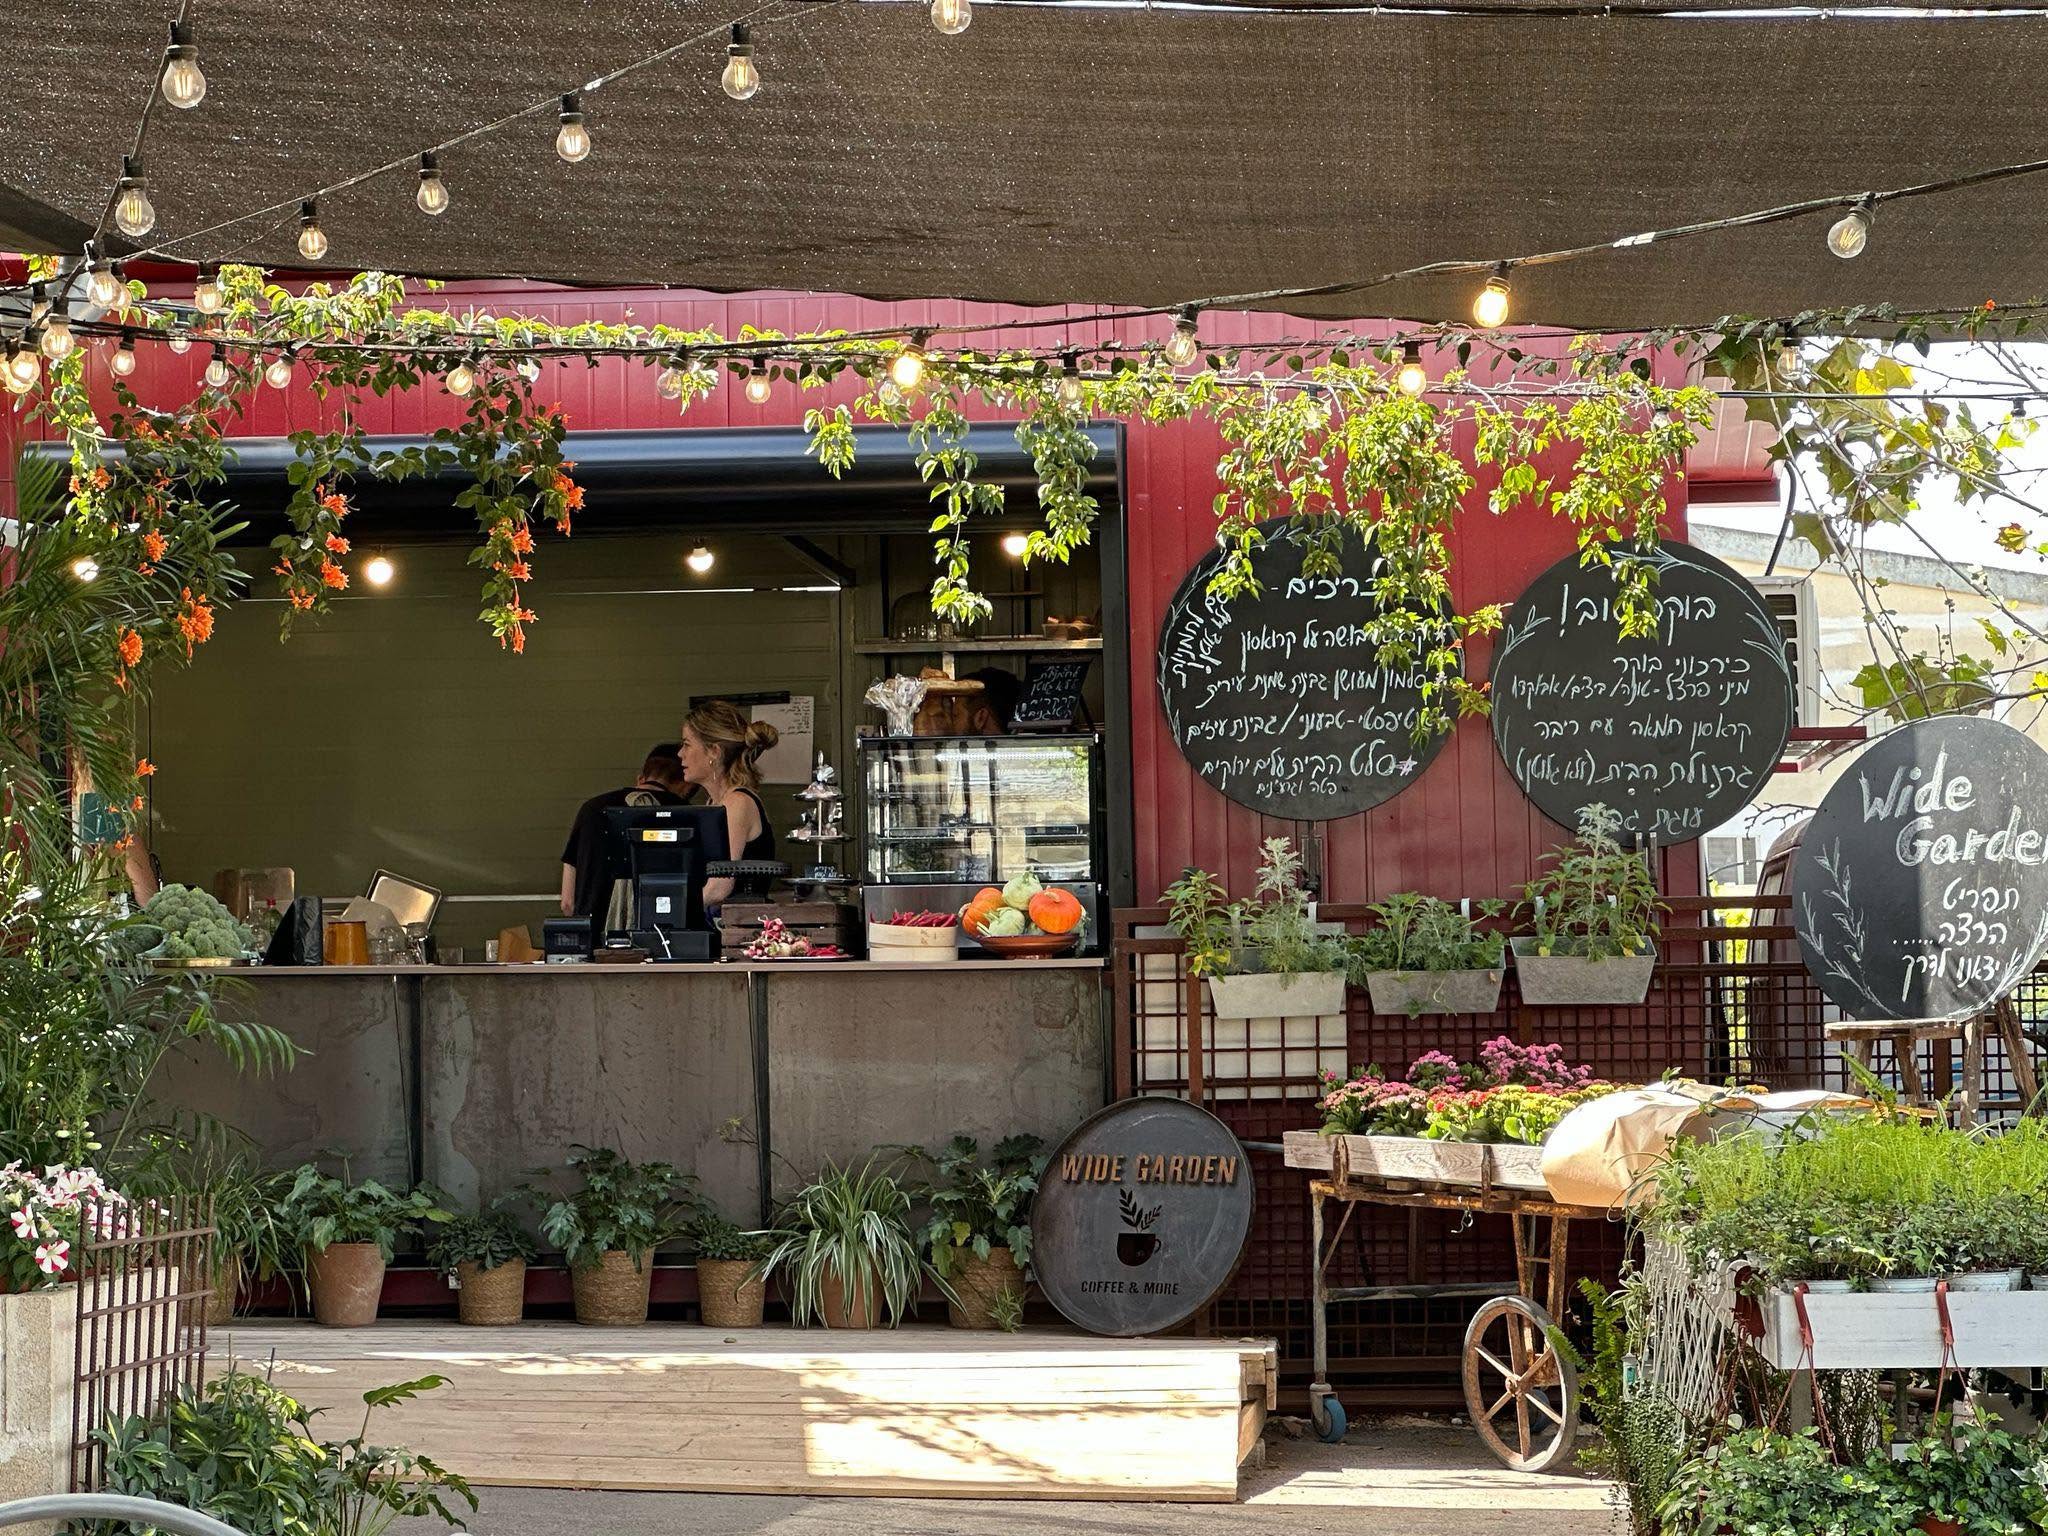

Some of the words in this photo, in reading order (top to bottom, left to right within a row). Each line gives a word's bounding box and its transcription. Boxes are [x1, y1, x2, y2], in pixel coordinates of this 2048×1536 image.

[1303, 619, 1319, 649] על
[1248, 670, 1287, 699] שמנת
[1288, 671, 1328, 699] גבינת
[1333, 665, 1379, 701] מעושן
[1612, 653, 1663, 688] בוקר
[1666, 673, 1711, 702] פרצל
[1533, 719, 1580, 740] ריבה
[1589, 717, 1614, 736] עם
[1628, 713, 1683, 739] חמאה
[1253, 747, 1286, 778] עלים
[1285, 755, 1342, 780] הבית
[1350, 738, 1397, 777] סלט
[1309, 777, 1337, 795] פטה
[1594, 761, 1658, 784] הבית
[1858, 740, 1976, 823] Wide
[1942, 877, 2020, 915] תפריט
[1901, 947, 1953, 1003] לדרך
[1956, 955, 2001, 989] יצאנו
[1061, 1153, 1125, 1184] WIDE
[1135, 1154, 1238, 1185] GARDEN
[1081, 1280, 1125, 1294] COFFEE
[1128, 1281, 1139, 1294] &
[1144, 1281, 1180, 1295] MORE
